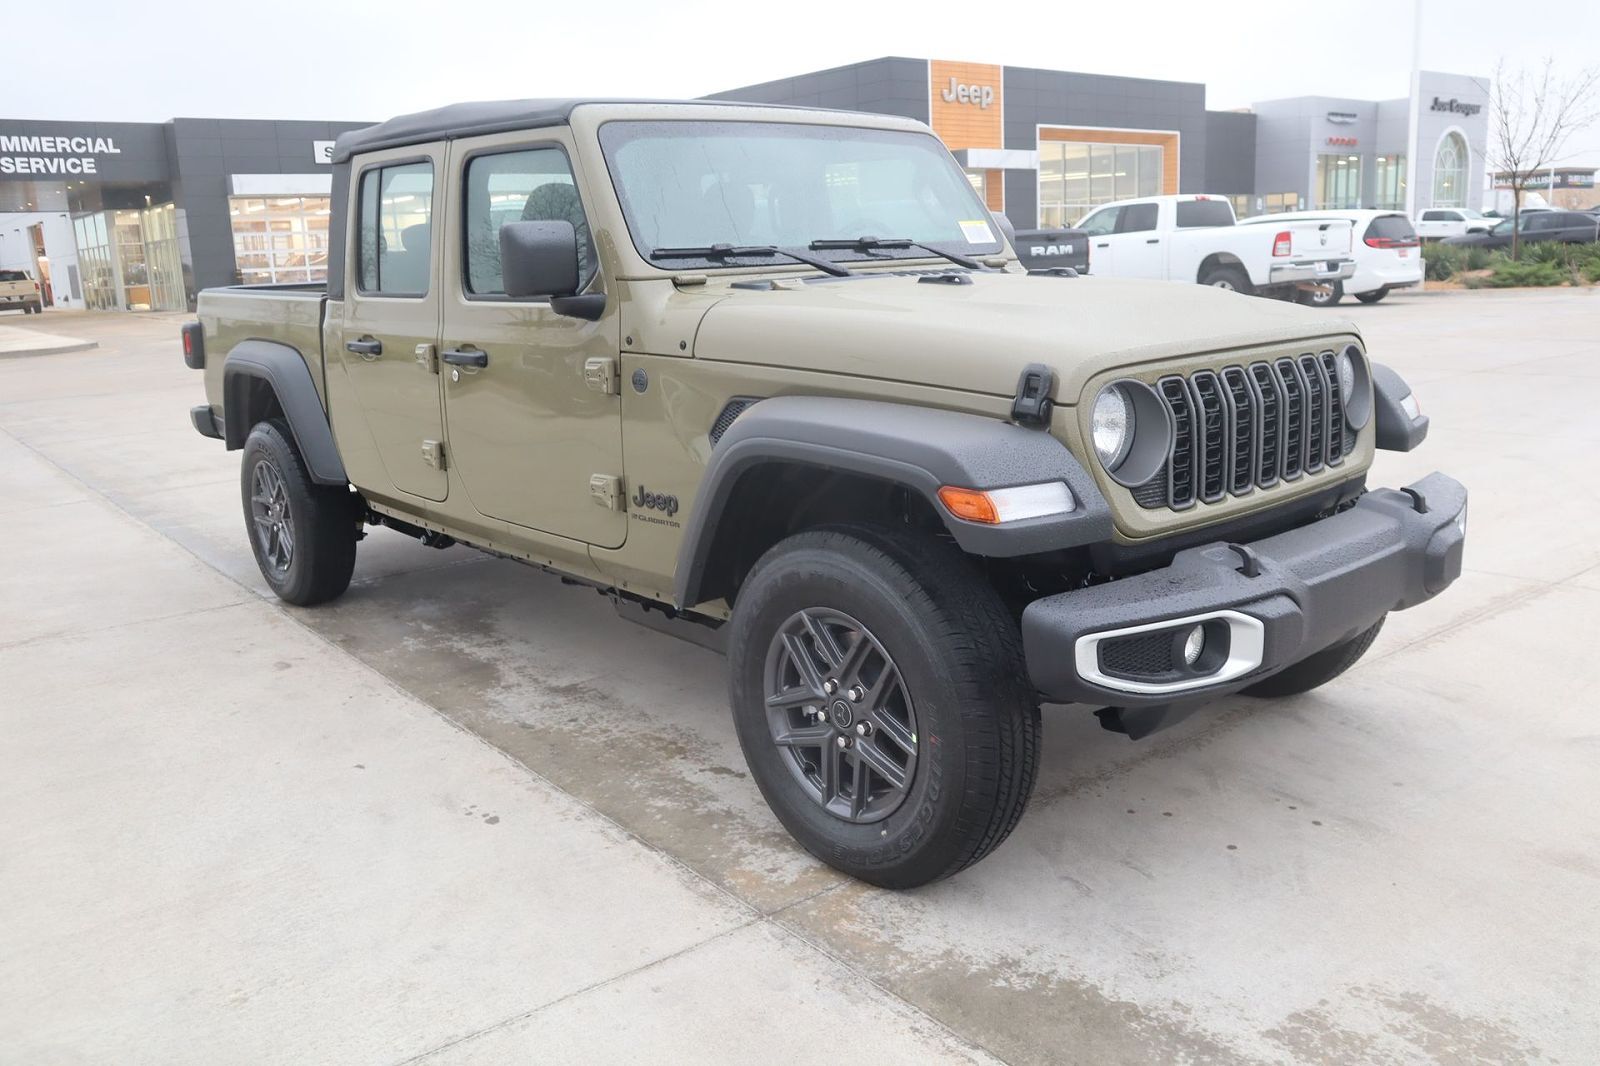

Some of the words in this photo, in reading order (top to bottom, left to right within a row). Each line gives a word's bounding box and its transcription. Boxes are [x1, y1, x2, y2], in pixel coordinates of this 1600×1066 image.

[942, 77, 993, 109] Jeep
[0, 136, 121, 154] MMERCIAL
[0, 157, 97, 174] SERVICE
[1030, 244, 1073, 256] RAM
[632, 485, 678, 518] Jeep
[638, 514, 680, 528] GLADIATOR
